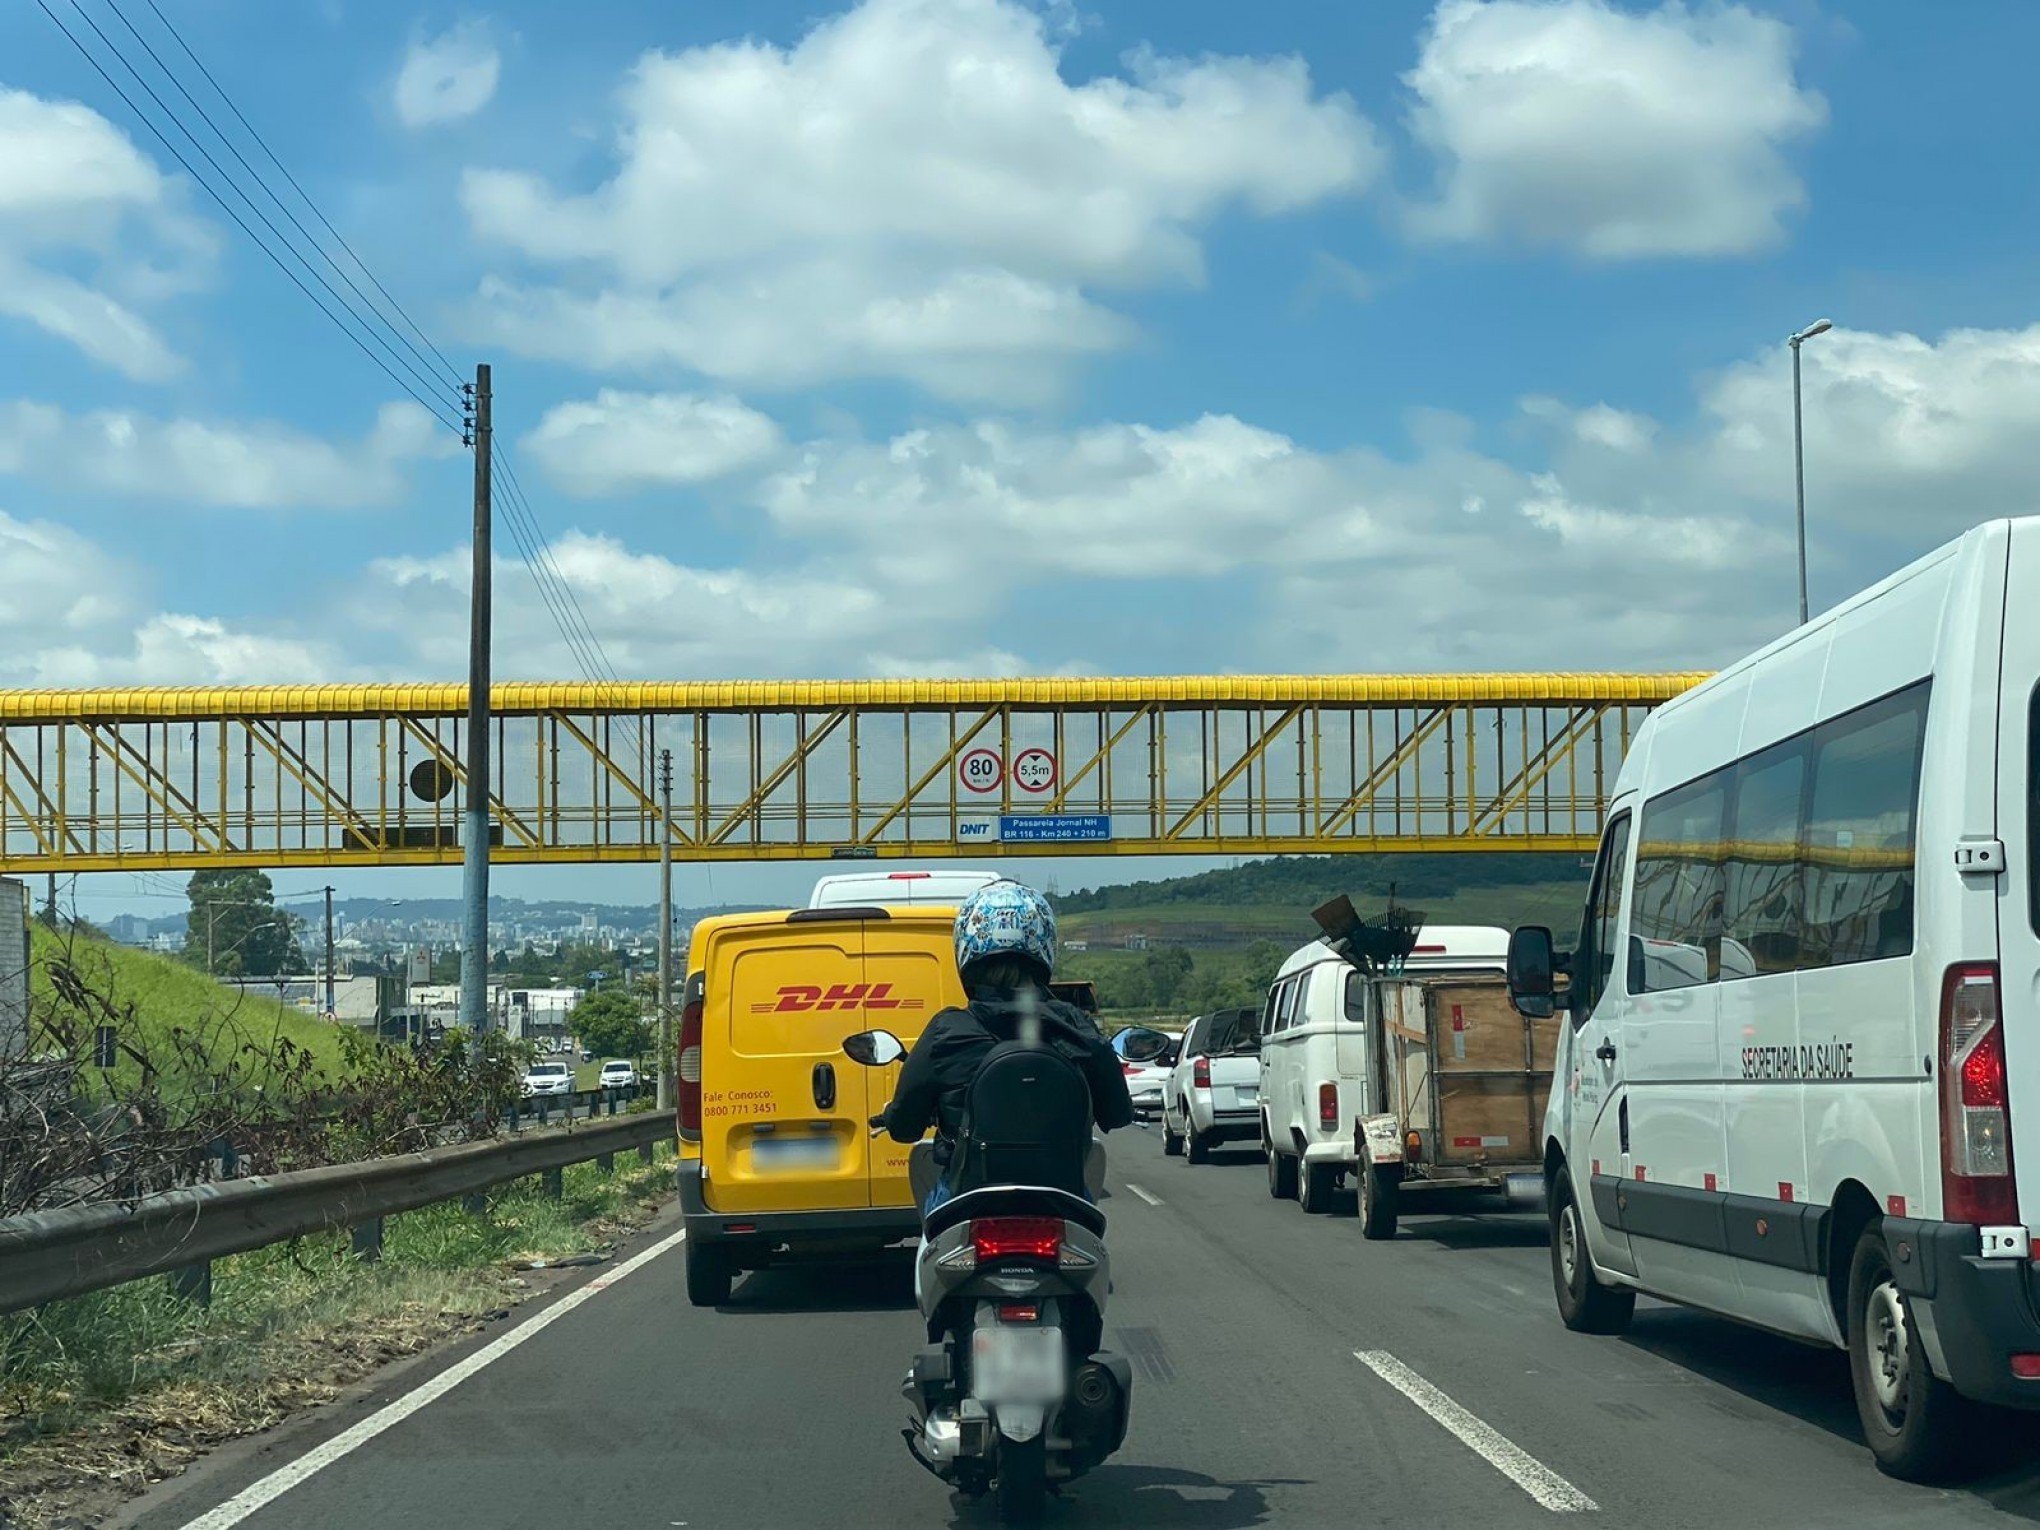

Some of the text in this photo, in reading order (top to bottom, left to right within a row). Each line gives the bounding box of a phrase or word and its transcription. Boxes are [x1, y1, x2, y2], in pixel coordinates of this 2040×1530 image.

[970, 759, 992, 775] 80
[1021, 765, 1049, 777] 5,5m
[1013, 818, 1097, 827] Passarela Jornal NH
[960, 823, 989, 835] DNIT
[1004, 830, 1017, 839] BR
[1019, 830, 1034, 838] 116
[1041, 830, 1055, 838] Km
[1080, 829, 1096, 837] 210
[774, 983, 901, 1012] DHL
[1742, 1034, 1853, 1079] SECRETARIA DA SAÚDE
[704, 1091, 723, 1102] Fale
[704, 1102, 776, 1117] 0800 771 3451
